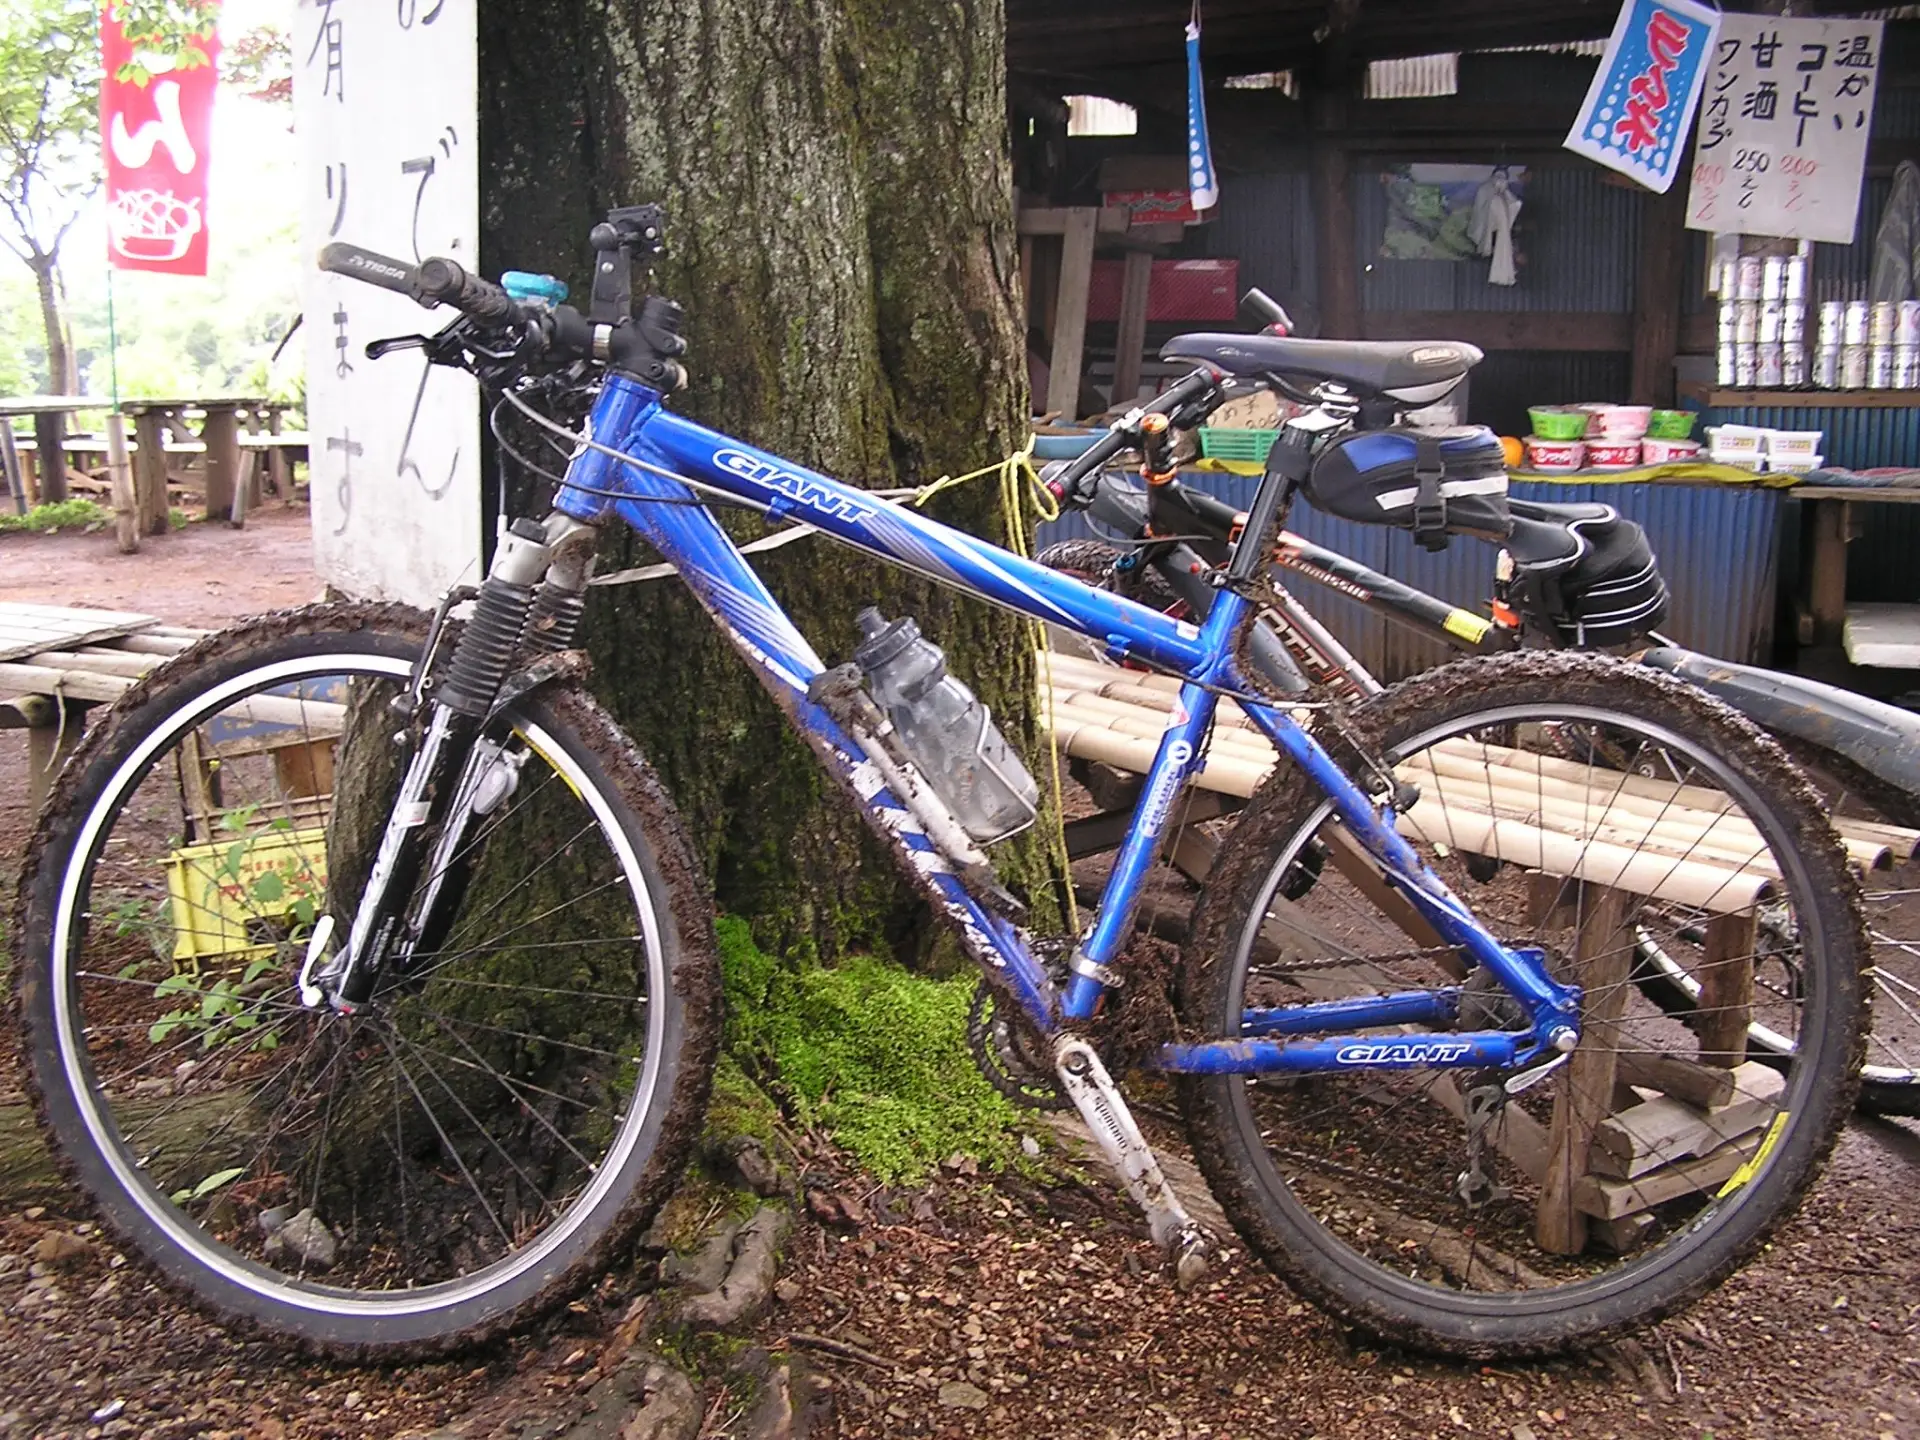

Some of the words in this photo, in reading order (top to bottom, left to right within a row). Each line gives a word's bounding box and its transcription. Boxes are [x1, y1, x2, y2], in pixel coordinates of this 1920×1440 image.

[1741, 31, 1783, 121] 甘酒
[1793, 43, 1829, 148] コーヒー
[1834, 35, 1876, 131] 温かい
[1732, 148, 1771, 173] 250
[712, 448, 880, 525] GIANT
[1336, 1043, 1471, 1064] GIANT
